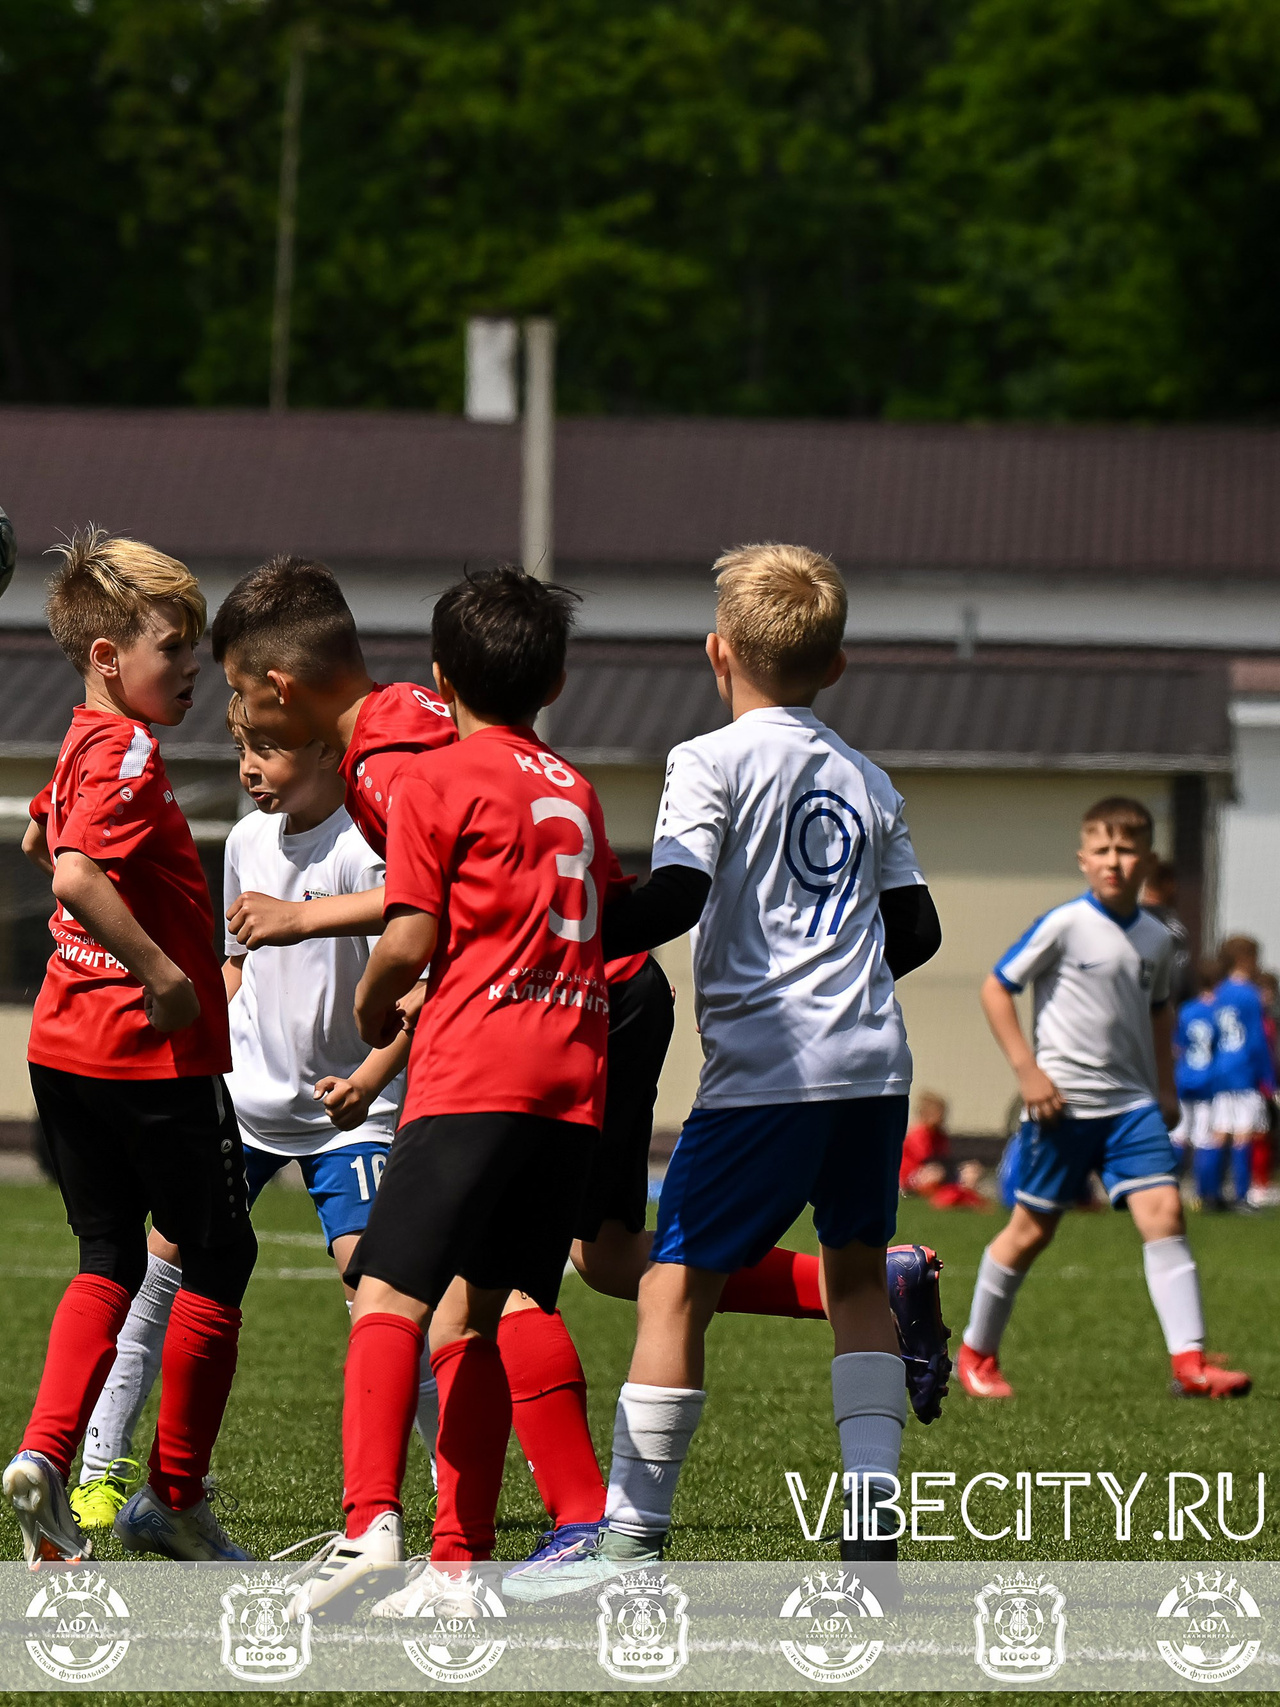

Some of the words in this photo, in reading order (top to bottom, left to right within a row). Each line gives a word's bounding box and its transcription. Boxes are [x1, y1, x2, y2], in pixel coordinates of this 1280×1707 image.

[530, 797, 598, 943] 3
[784, 789, 866, 938] 9
[488, 982, 609, 1016] КАЛИНИНГР
